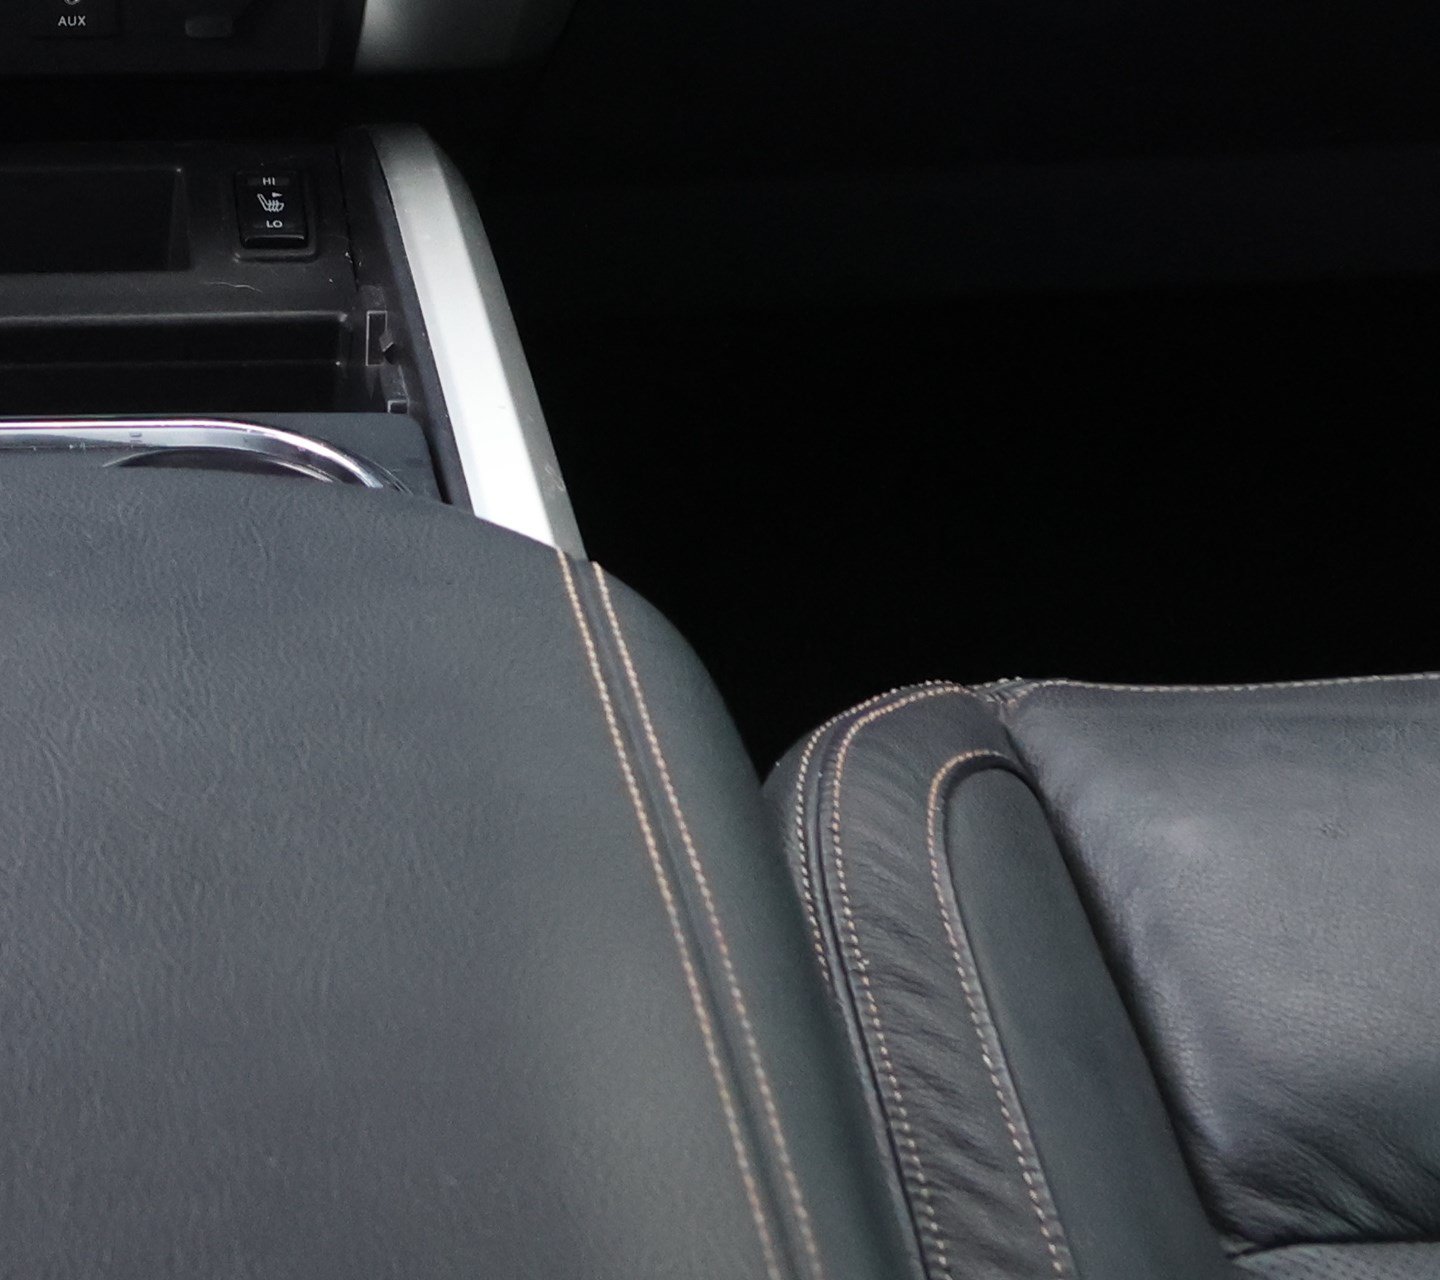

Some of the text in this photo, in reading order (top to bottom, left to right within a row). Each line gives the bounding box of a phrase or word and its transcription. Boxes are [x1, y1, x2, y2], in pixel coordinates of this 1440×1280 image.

[57, 15, 87, 27] AUX
[262, 177, 276, 186] HI
[266, 220, 283, 228] LO
